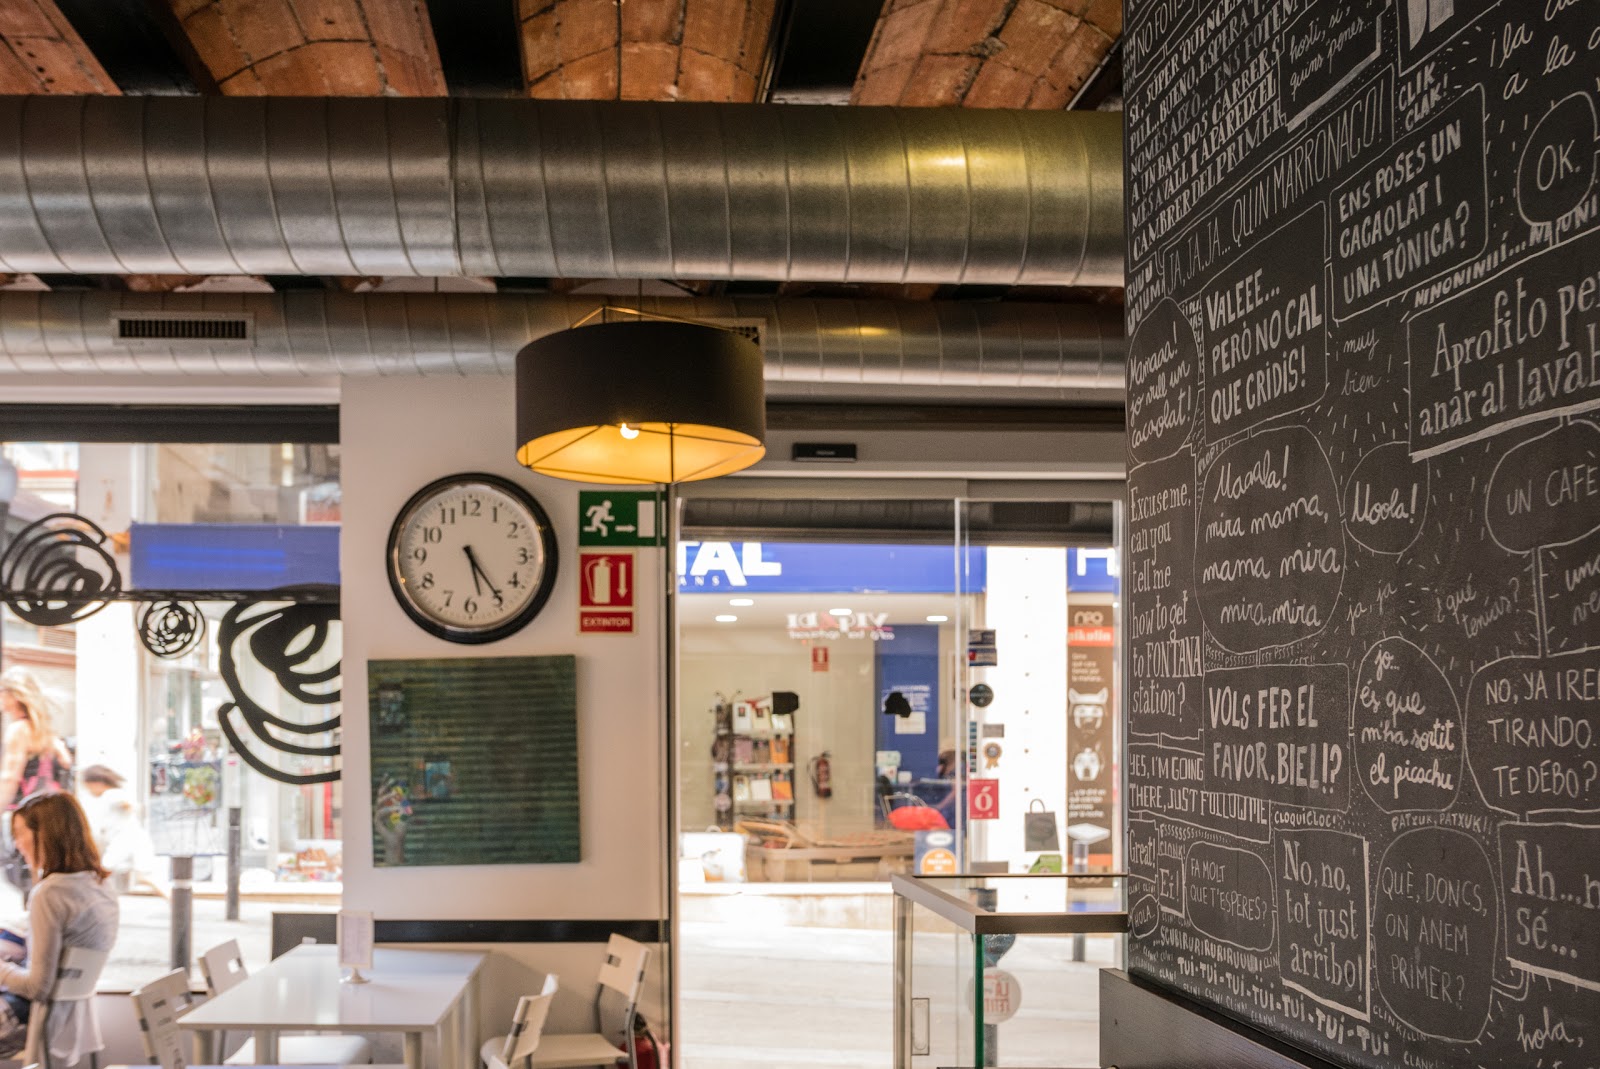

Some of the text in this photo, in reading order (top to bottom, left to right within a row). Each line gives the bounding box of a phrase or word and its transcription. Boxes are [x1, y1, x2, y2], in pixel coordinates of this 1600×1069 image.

[1157, 143, 1180, 180] BAR
[1183, 111, 1208, 157] DOS
[1192, 164, 1219, 207] DEL
[1339, 119, 1461, 223] ENS POSES UN
[1436, 174, 1443, 206] I
[1343, 259, 1381, 304] UNA
[1256, 310, 1281, 355] NO
[1285, 284, 1322, 340] CAL
[1558, 272, 1600, 351] pe
[1211, 378, 1242, 424] QUE
[1481, 363, 1507, 417] al
[461, 499, 481, 517] 12
[1507, 480, 1532, 515] UN
[440, 507, 456, 525] 11
[491, 505, 498, 523] 1
[1206, 512, 1245, 543] mira
[423, 527, 442, 544] 10
[507, 522, 518, 539] 2
[414, 547, 427, 564] 9
[518, 547, 528, 565] 3
[1203, 542, 1340, 583] mama mira
[422, 572, 434, 589] 8
[508, 572, 520, 589] 4
[443, 590, 453, 607] 7
[465, 598, 477, 614] 6
[494, 589, 504, 607] 5
[583, 616, 631, 627] EXTINTOR
[1486, 668, 1600, 705] NO, YA IRE
[1208, 684, 1318, 730] VOLS FER EL
[1386, 690, 1426, 728] que
[1171, 757, 1204, 780] GOING
[1370, 752, 1389, 785] el
[1493, 765, 1520, 797] TE
[1168, 787, 1198, 812] JUST
[1285, 889, 1358, 947] tot just
[1385, 914, 1468, 955] ON ANEM
